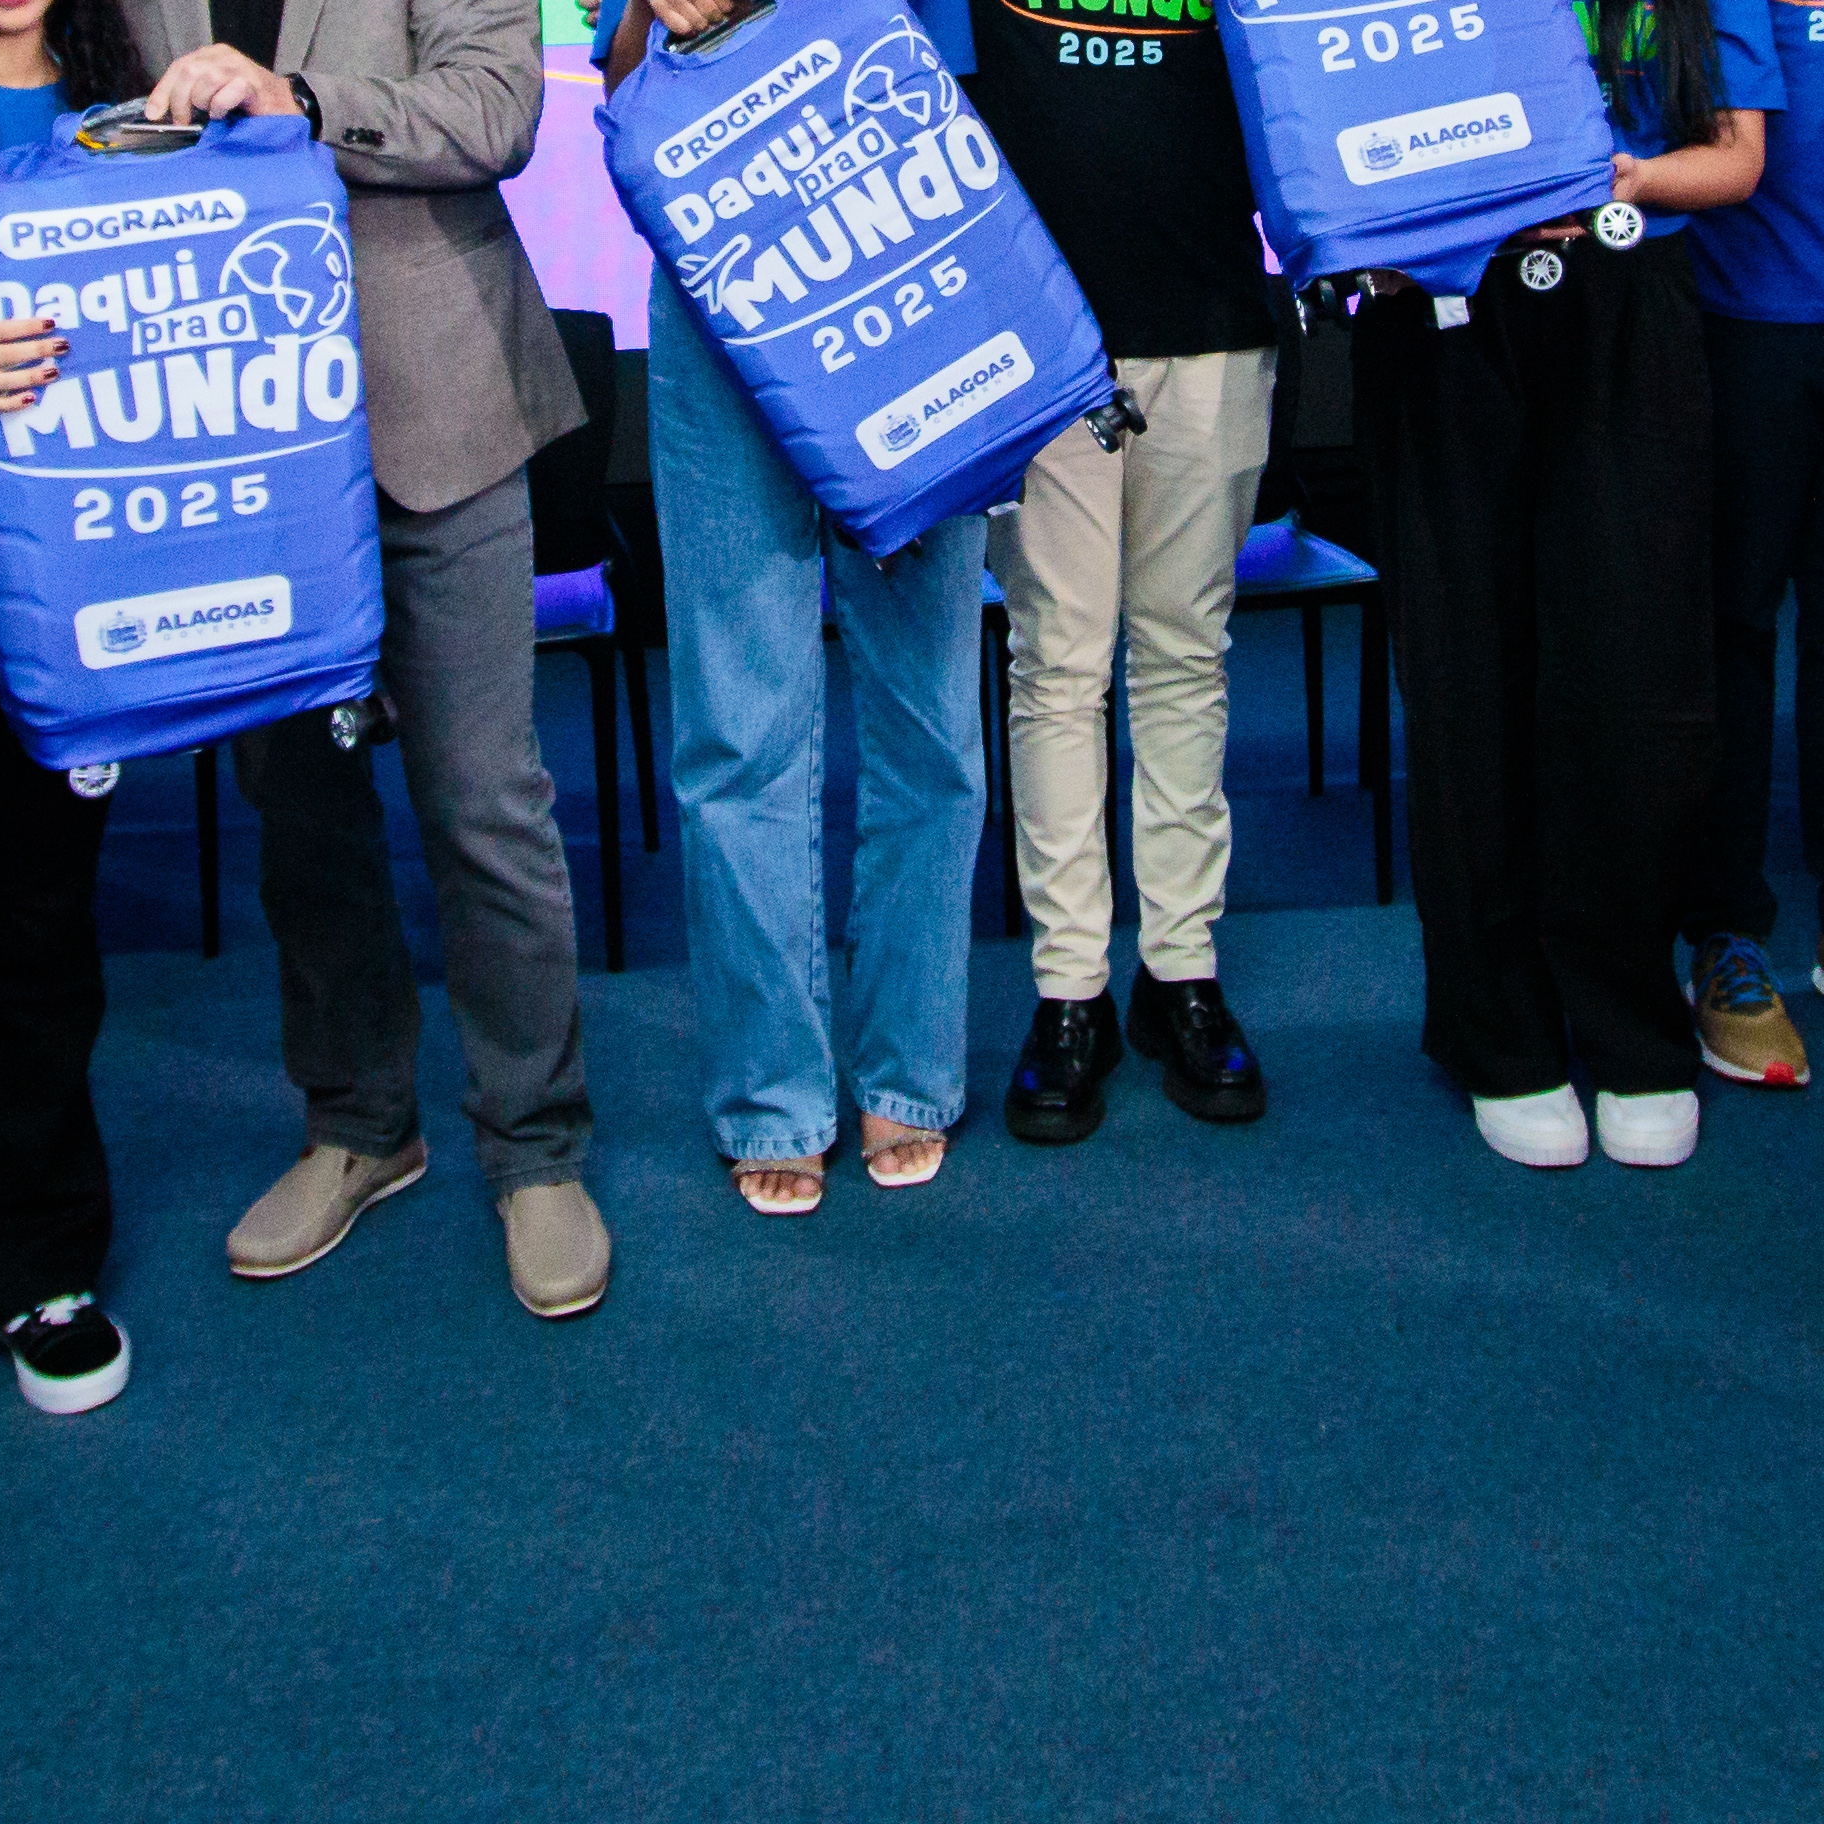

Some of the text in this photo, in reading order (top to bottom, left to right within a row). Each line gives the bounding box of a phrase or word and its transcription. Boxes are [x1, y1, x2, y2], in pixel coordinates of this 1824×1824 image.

[1059, 32, 1163, 65] 2025
[1317, 3, 1485, 73] 2025
[663, 51, 833, 170] PROGRAMA
[1408, 114, 1513, 152] ALAGOAS
[796, 149, 857, 204] pra
[10, 200, 235, 251] PROGRAMA
[138, 314, 207, 354] pra
[812, 255, 968, 374] 2025
[923, 353, 1016, 421] ALAGOAS
[73, 473, 270, 541] 2025
[155, 598, 275, 633] ALAGOAS
